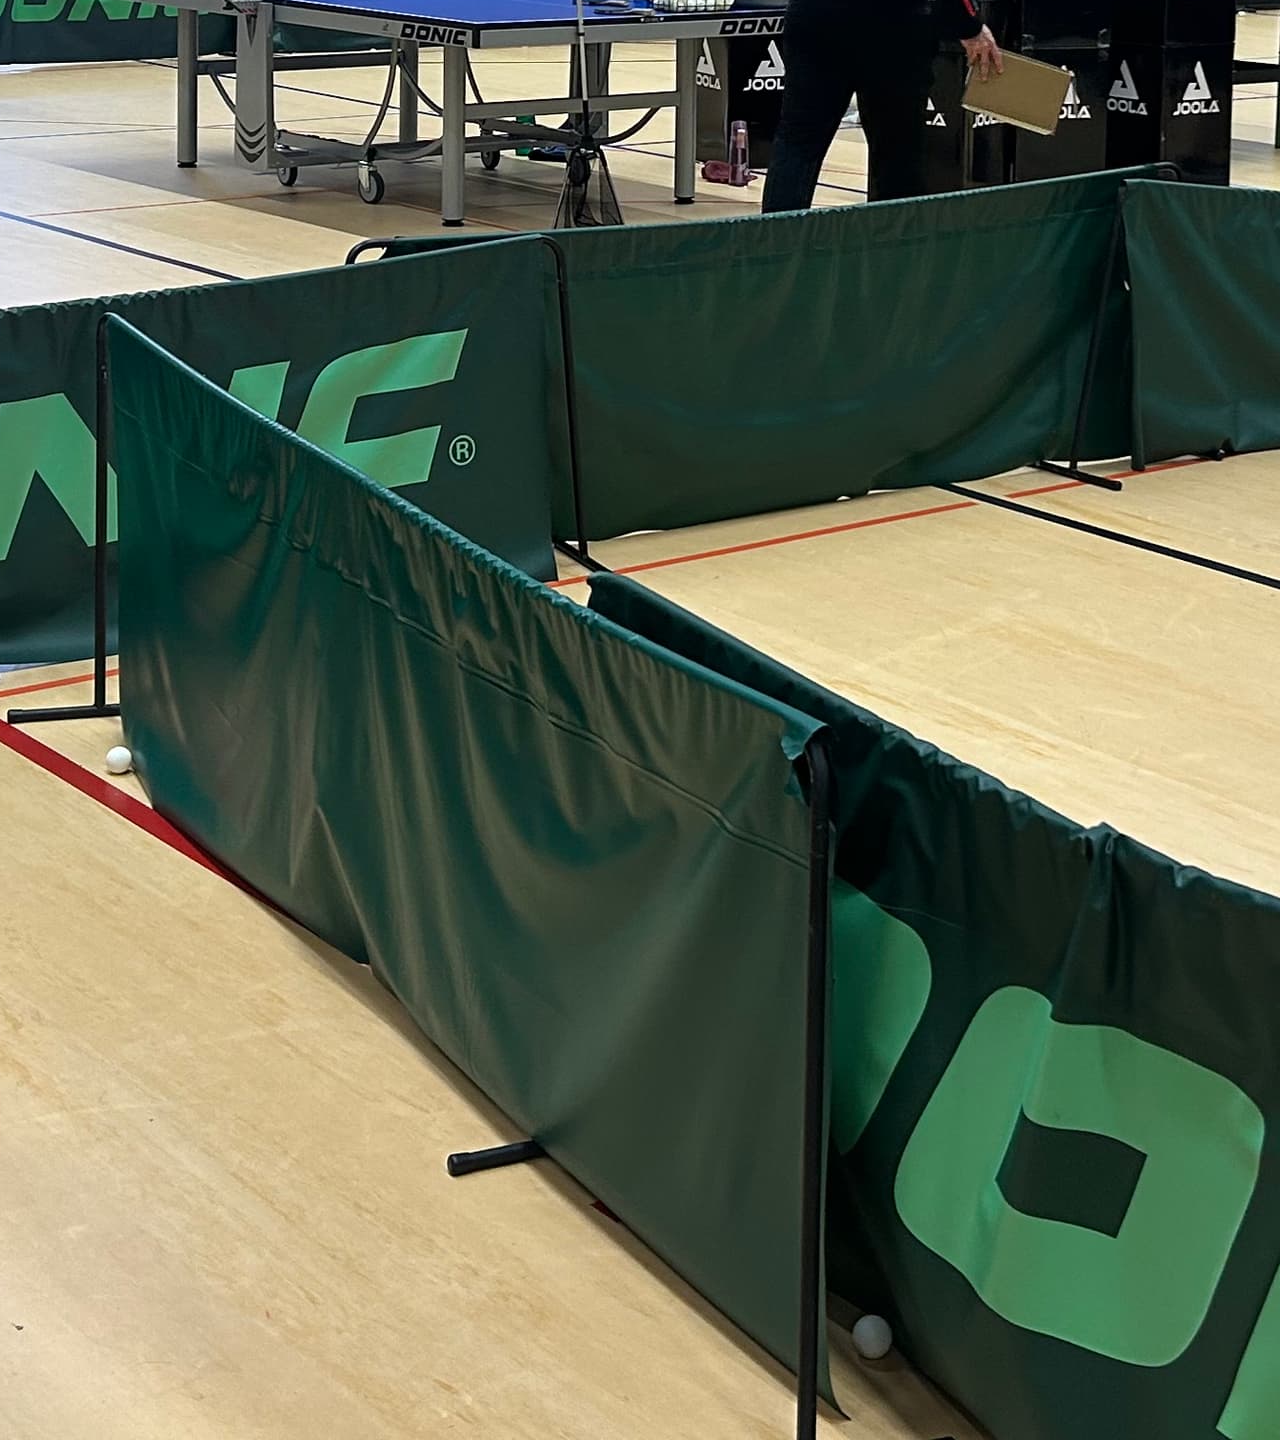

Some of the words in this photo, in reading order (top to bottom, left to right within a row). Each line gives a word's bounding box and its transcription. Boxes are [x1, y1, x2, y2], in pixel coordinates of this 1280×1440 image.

[720, 18, 784, 34] DONI
[400, 24, 468, 45] DONIC
[743, 78, 784, 91] JOOL
[1172, 100, 1219, 116] JOOLA
